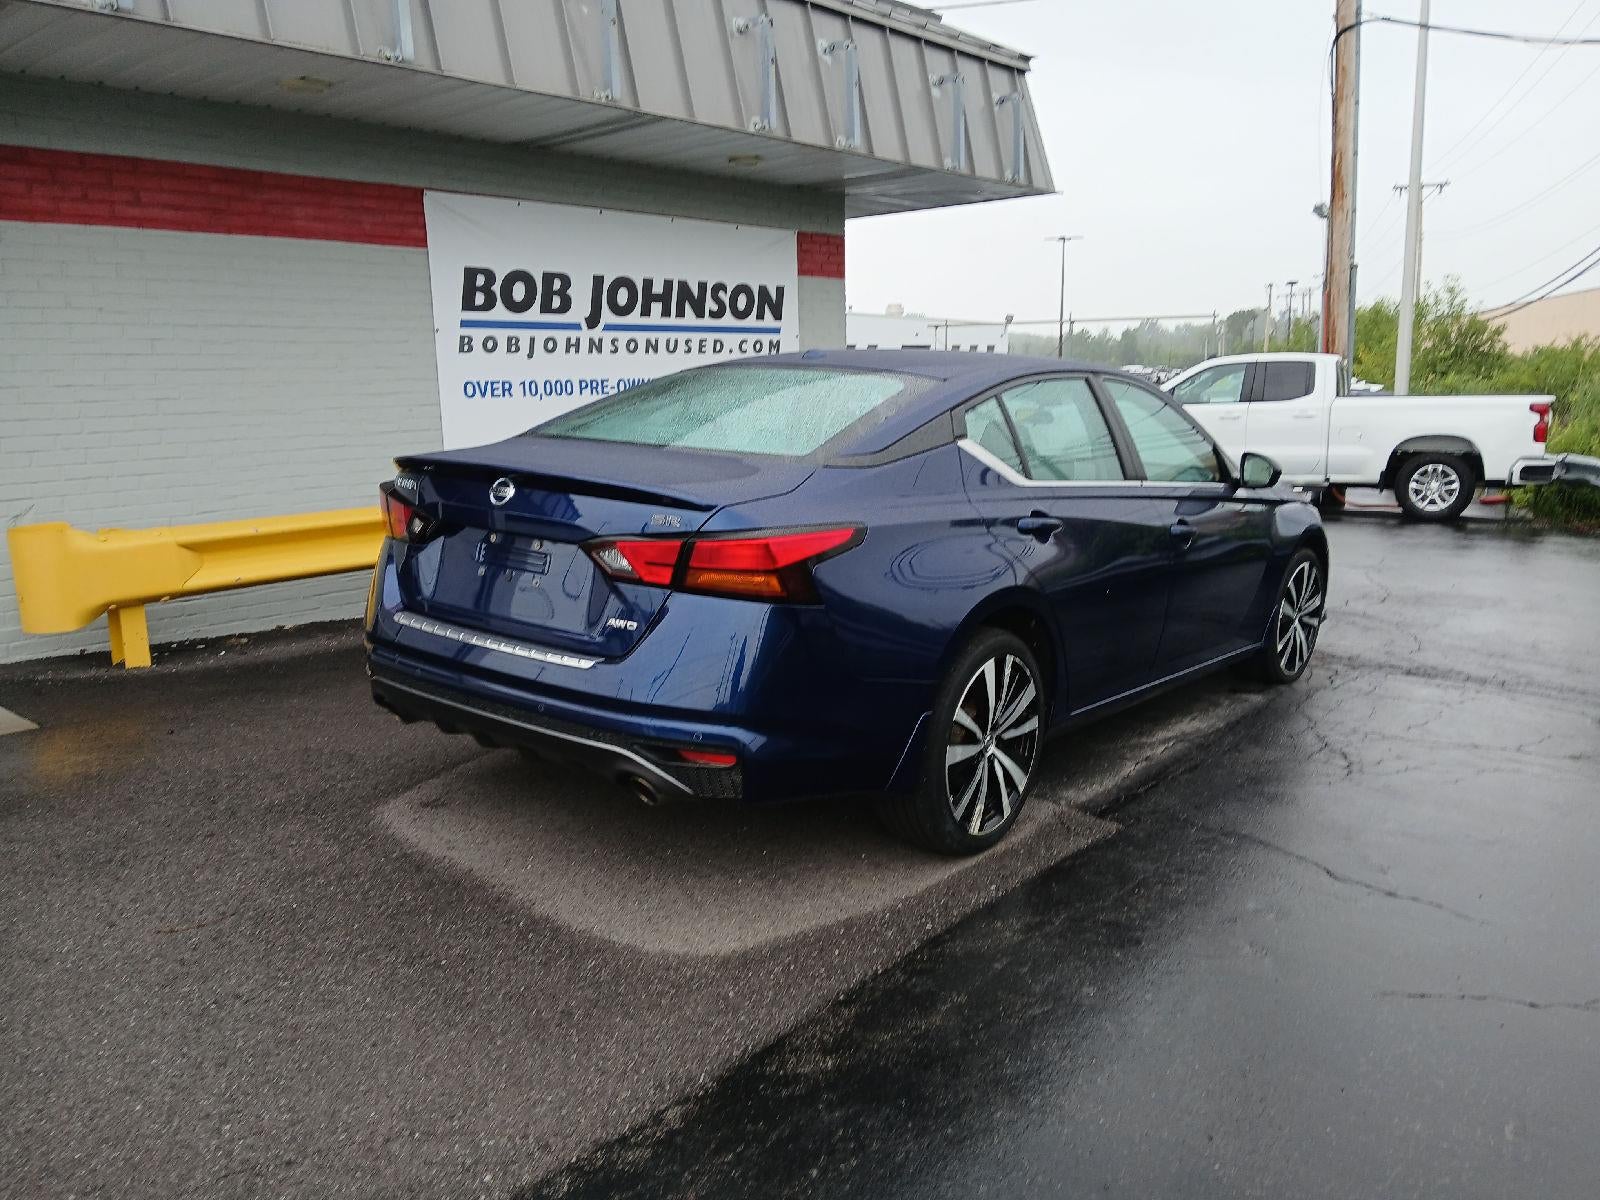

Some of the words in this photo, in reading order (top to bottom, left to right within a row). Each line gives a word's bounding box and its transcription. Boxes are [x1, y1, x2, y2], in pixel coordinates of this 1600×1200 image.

[461, 266, 573, 314] BOB
[584, 273, 786, 330] JOHNSON
[458, 334, 782, 360] BOBJOHNSONUSED.COM
[463, 380, 513, 399] OVER
[518, 378, 574, 401] 10,000
[606, 617, 638, 632] AWD
